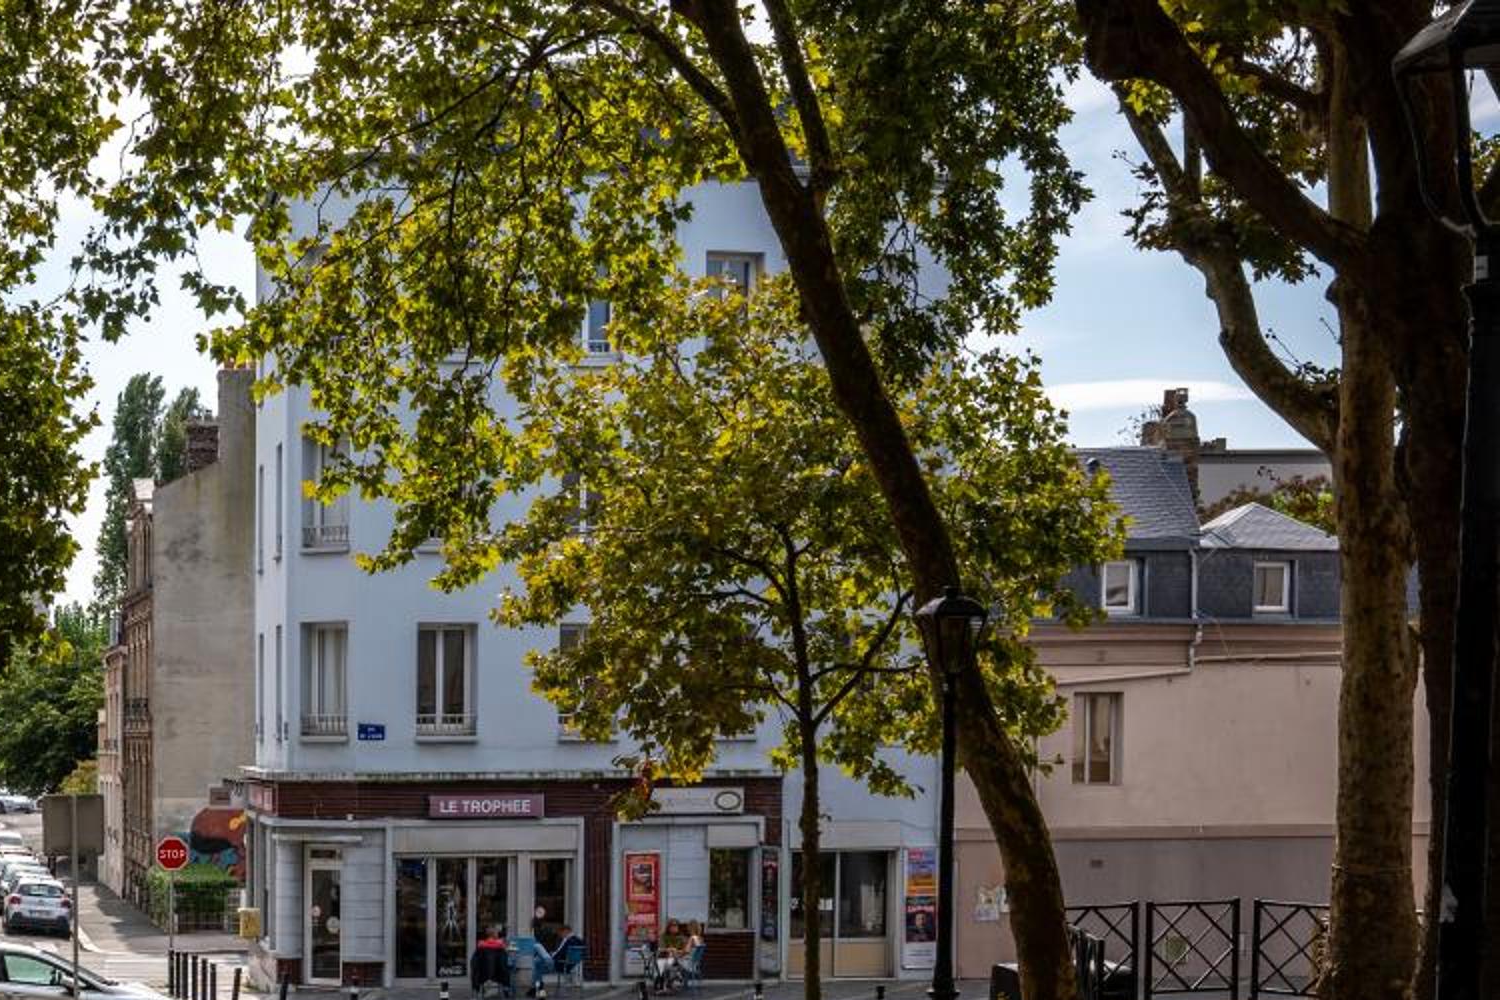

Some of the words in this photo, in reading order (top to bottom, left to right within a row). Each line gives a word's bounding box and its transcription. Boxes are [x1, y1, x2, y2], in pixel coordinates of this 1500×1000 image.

[440, 800, 458, 813] LE
[461, 799, 531, 813] TROPHEE
[160, 849, 187, 859] STOP
